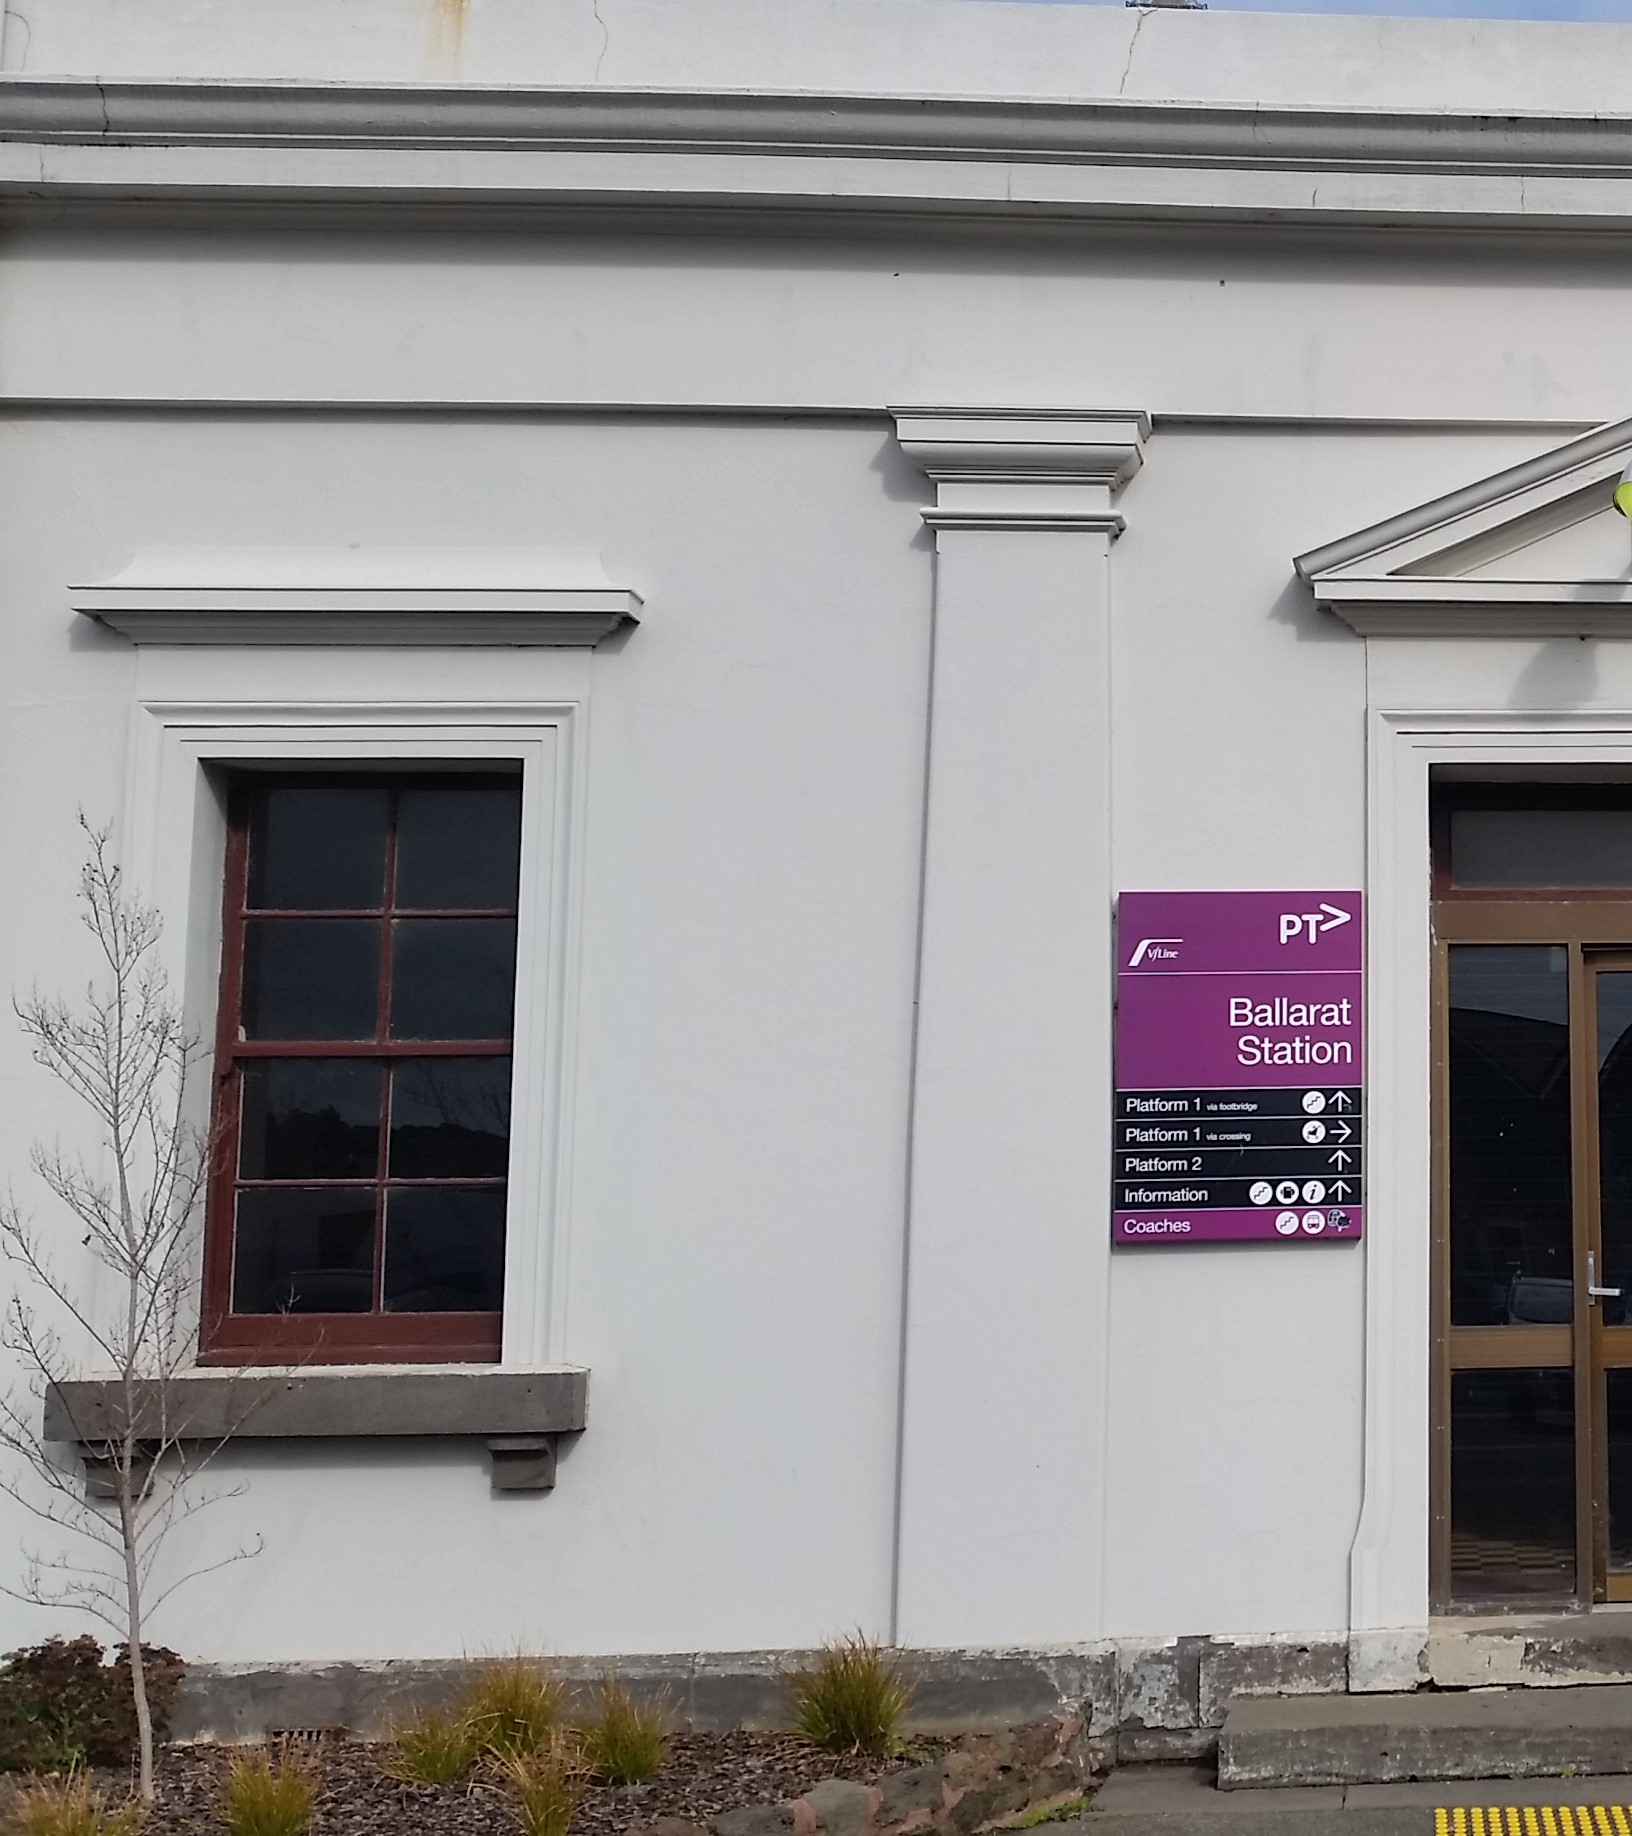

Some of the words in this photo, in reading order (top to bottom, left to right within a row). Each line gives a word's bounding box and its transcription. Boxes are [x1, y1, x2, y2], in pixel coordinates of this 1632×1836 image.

[1229, 997, 1351, 1026] Ballarat
[1237, 1035, 1352, 1065] Station
[1126, 1098, 1188, 1112] Platform
[1193, 1097, 1201, 1111] 1
[1219, 1102, 1258, 1112] footbridge
[1125, 1128, 1187, 1142] Platform
[1193, 1127, 1201, 1141] 1
[1206, 1132, 1218, 1140] via
[1219, 1132, 1251, 1142] crossing
[1125, 1158, 1187, 1172] Platform
[1192, 1157, 1202, 1171] 2
[1124, 1188, 1208, 1202] Information
[1124, 1219, 1191, 1234] Coaches
